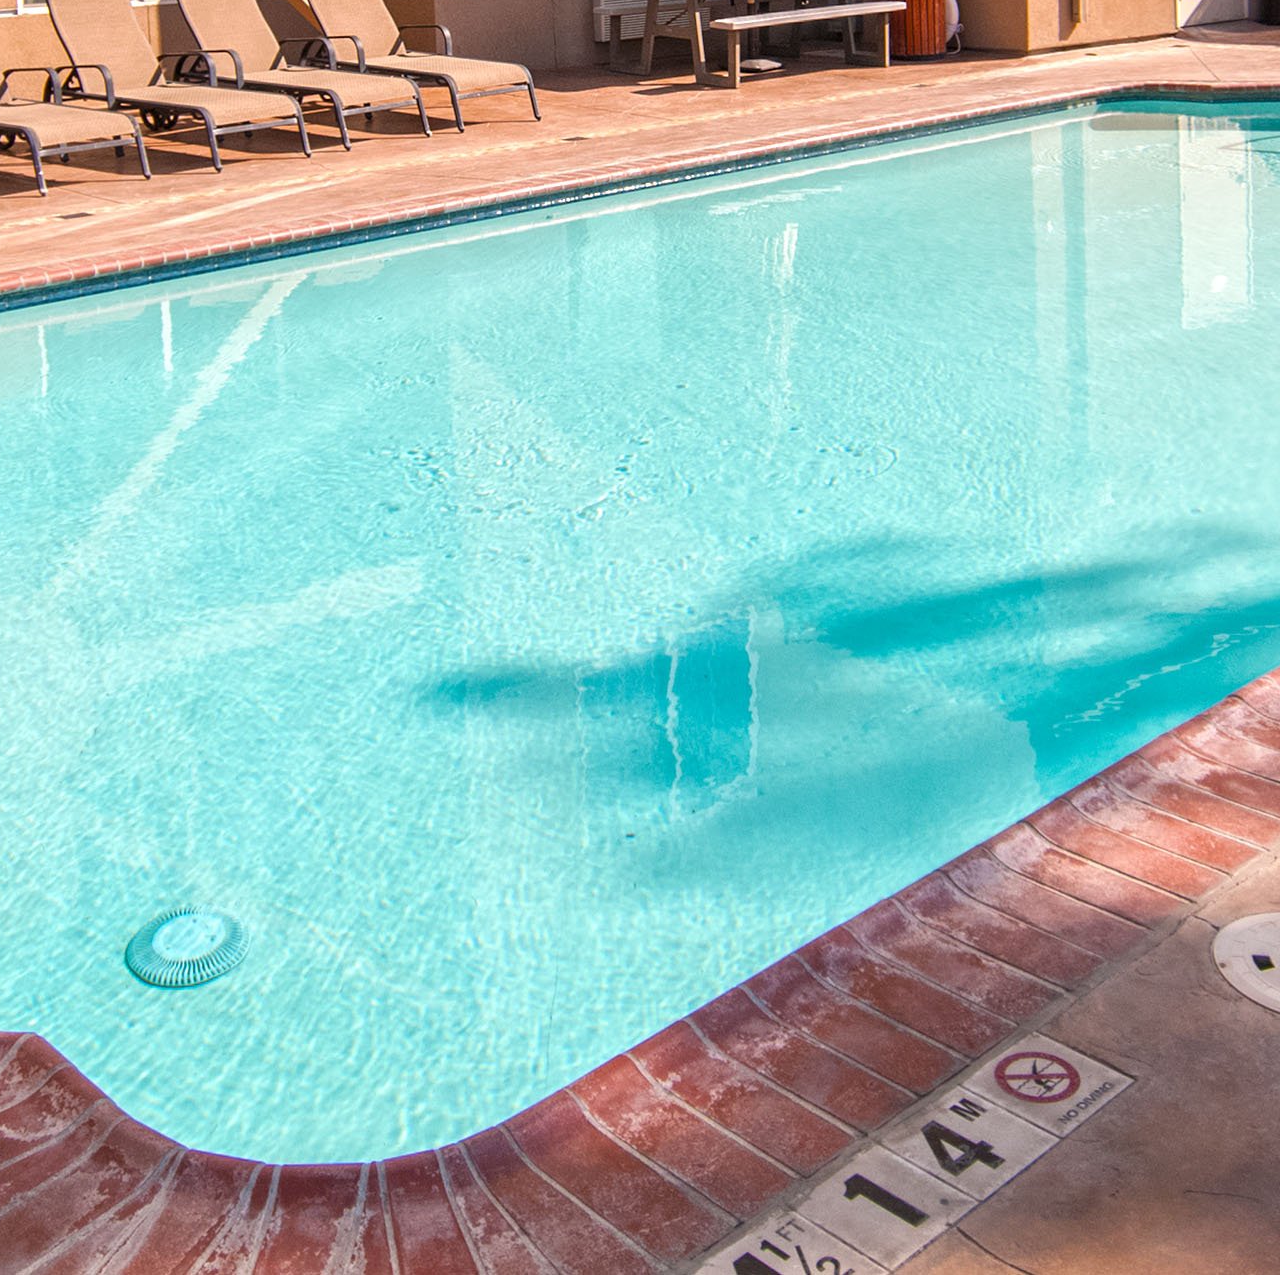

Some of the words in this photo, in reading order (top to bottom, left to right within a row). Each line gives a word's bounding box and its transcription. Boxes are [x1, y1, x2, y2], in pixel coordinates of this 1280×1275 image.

[1058, 1108, 1078, 1125] NO
[1076, 1081, 1114, 1113] DIVING
[775, 1218, 805, 1242] FT
[950, 1098, 987, 1122] M
